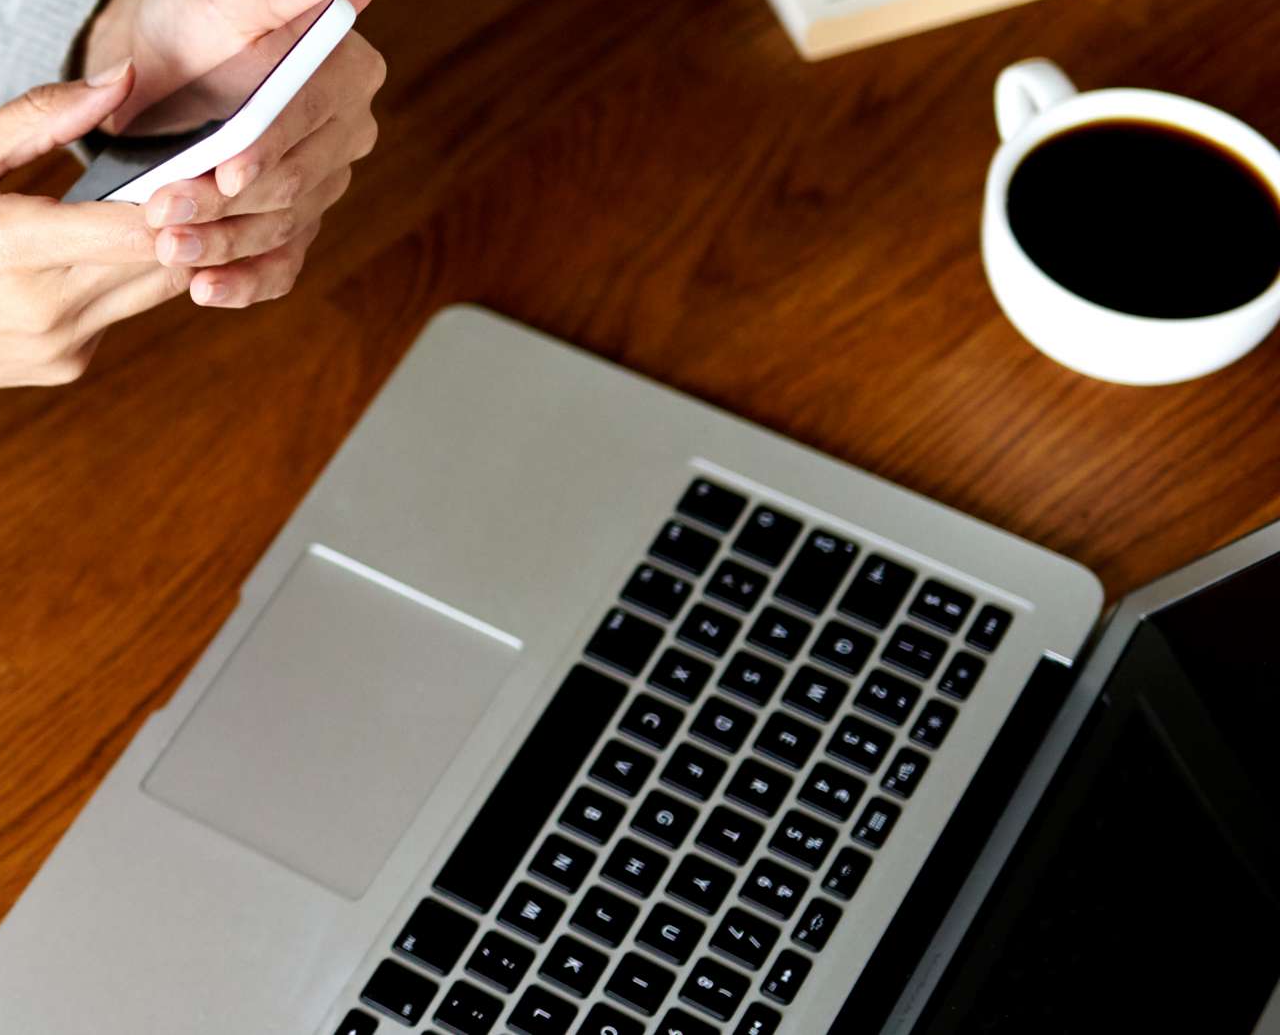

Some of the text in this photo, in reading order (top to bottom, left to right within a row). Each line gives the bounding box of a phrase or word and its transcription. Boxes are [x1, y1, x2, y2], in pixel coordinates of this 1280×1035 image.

[701, 621, 718, 637] Z
[672, 666, 689, 682] X
[807, 684, 827, 702] W
[871, 685, 887, 698] 2
[642, 713, 660, 728] C
[780, 732, 797, 746] E
[844, 732, 859, 745] 3
[751, 779, 768, 793] R
[815, 780, 829, 792] 4
[584, 807, 602, 820] B
[533, 624, 788, 1019] A S D F G H J K L
[723, 829, 740, 841] T
[787, 827, 802, 840] 5
[553, 854, 572, 871] N
[693, 878, 710, 891] Y
[757, 876, 772, 888] 6
[521, 901, 541, 919] M
[662, 925, 680, 941] U
[729, 926, 744, 939] 7
[698, 976, 713, 989] 8
